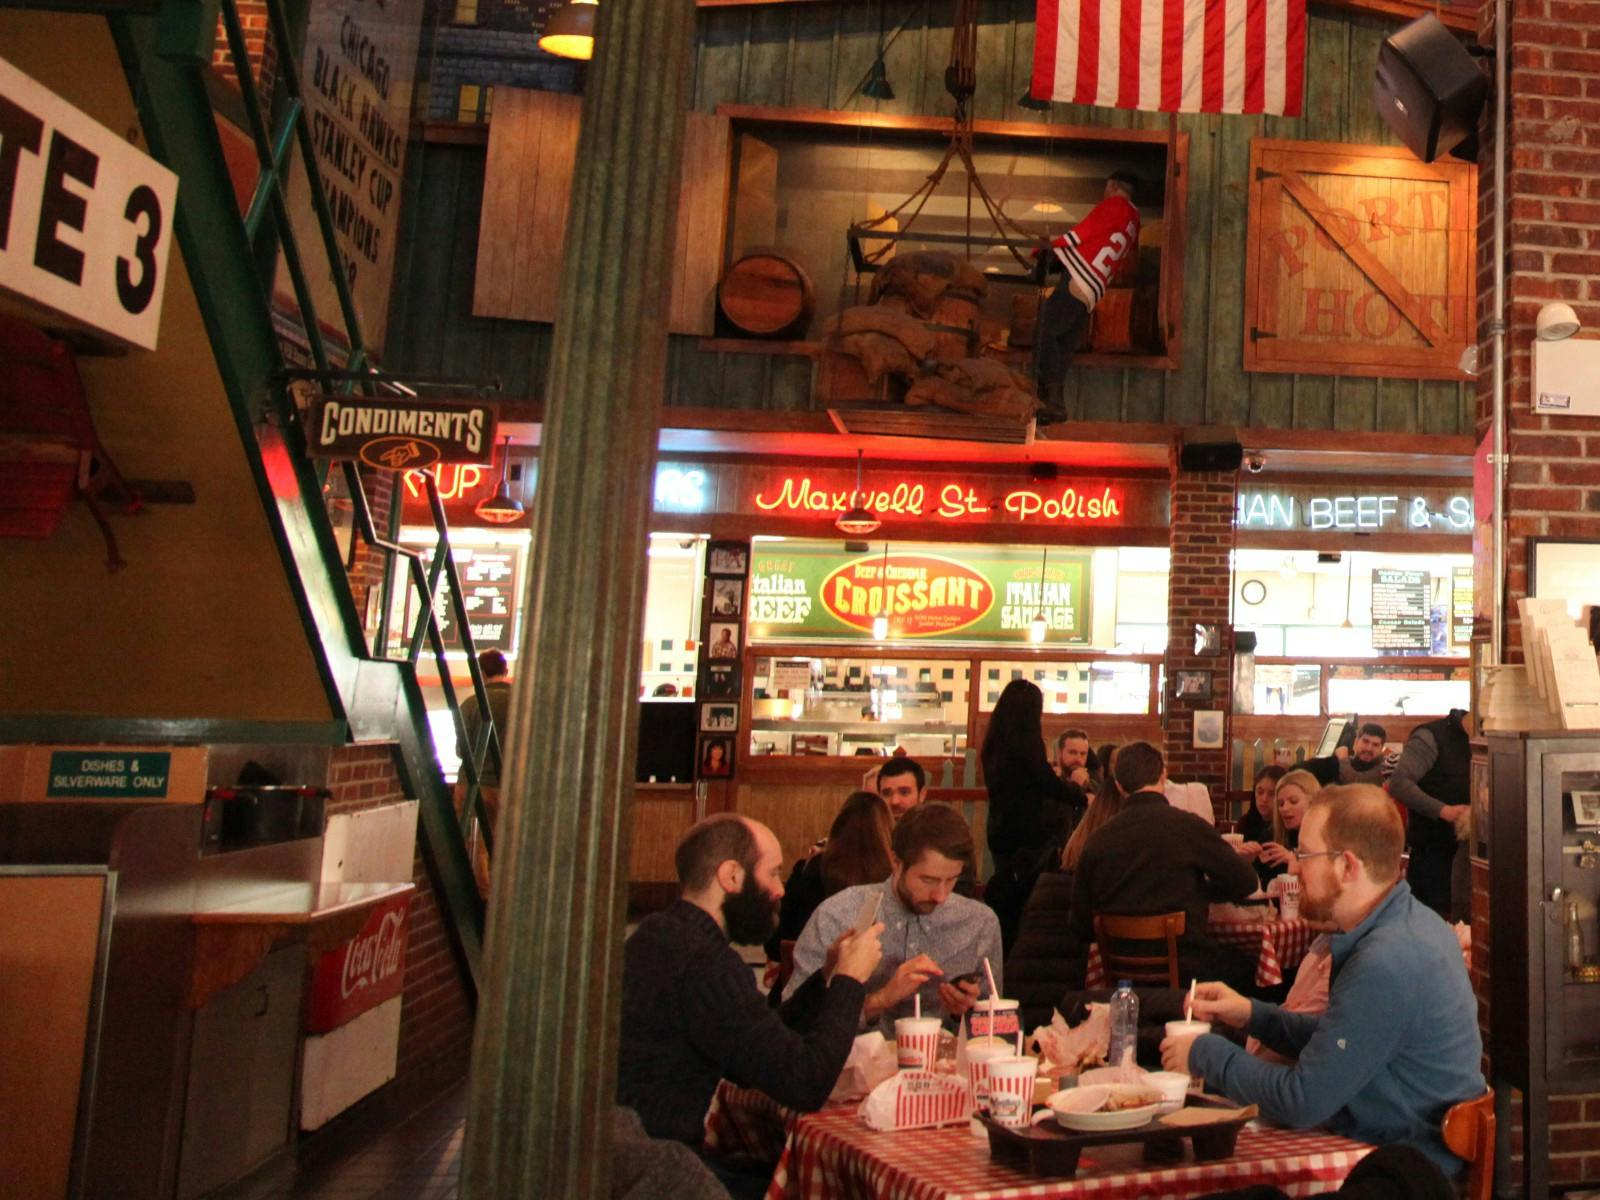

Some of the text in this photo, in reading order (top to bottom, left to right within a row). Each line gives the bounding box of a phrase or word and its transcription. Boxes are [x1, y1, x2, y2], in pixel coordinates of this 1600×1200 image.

[341, 15, 389, 100] CHICAGO
[313, 109, 393, 216] STANLEY CUP
[0, 93, 162, 315] TE 3
[323, 175, 381, 264] AMPIONS
[1268, 190, 1446, 277] PORT
[320, 401, 484, 454] CONDIMENTS
[1004, 487, 1119, 521] Polish
[1310, 496, 1395, 529] BEEF
[1410, 496, 1431, 529] &
[834, 576, 984, 616] CROISSANT
[1006, 581, 1071, 606] ITALIAN
[53, 775, 165, 788] SILVERWARE ONLY
[81, 759, 140, 772] DISHES &
